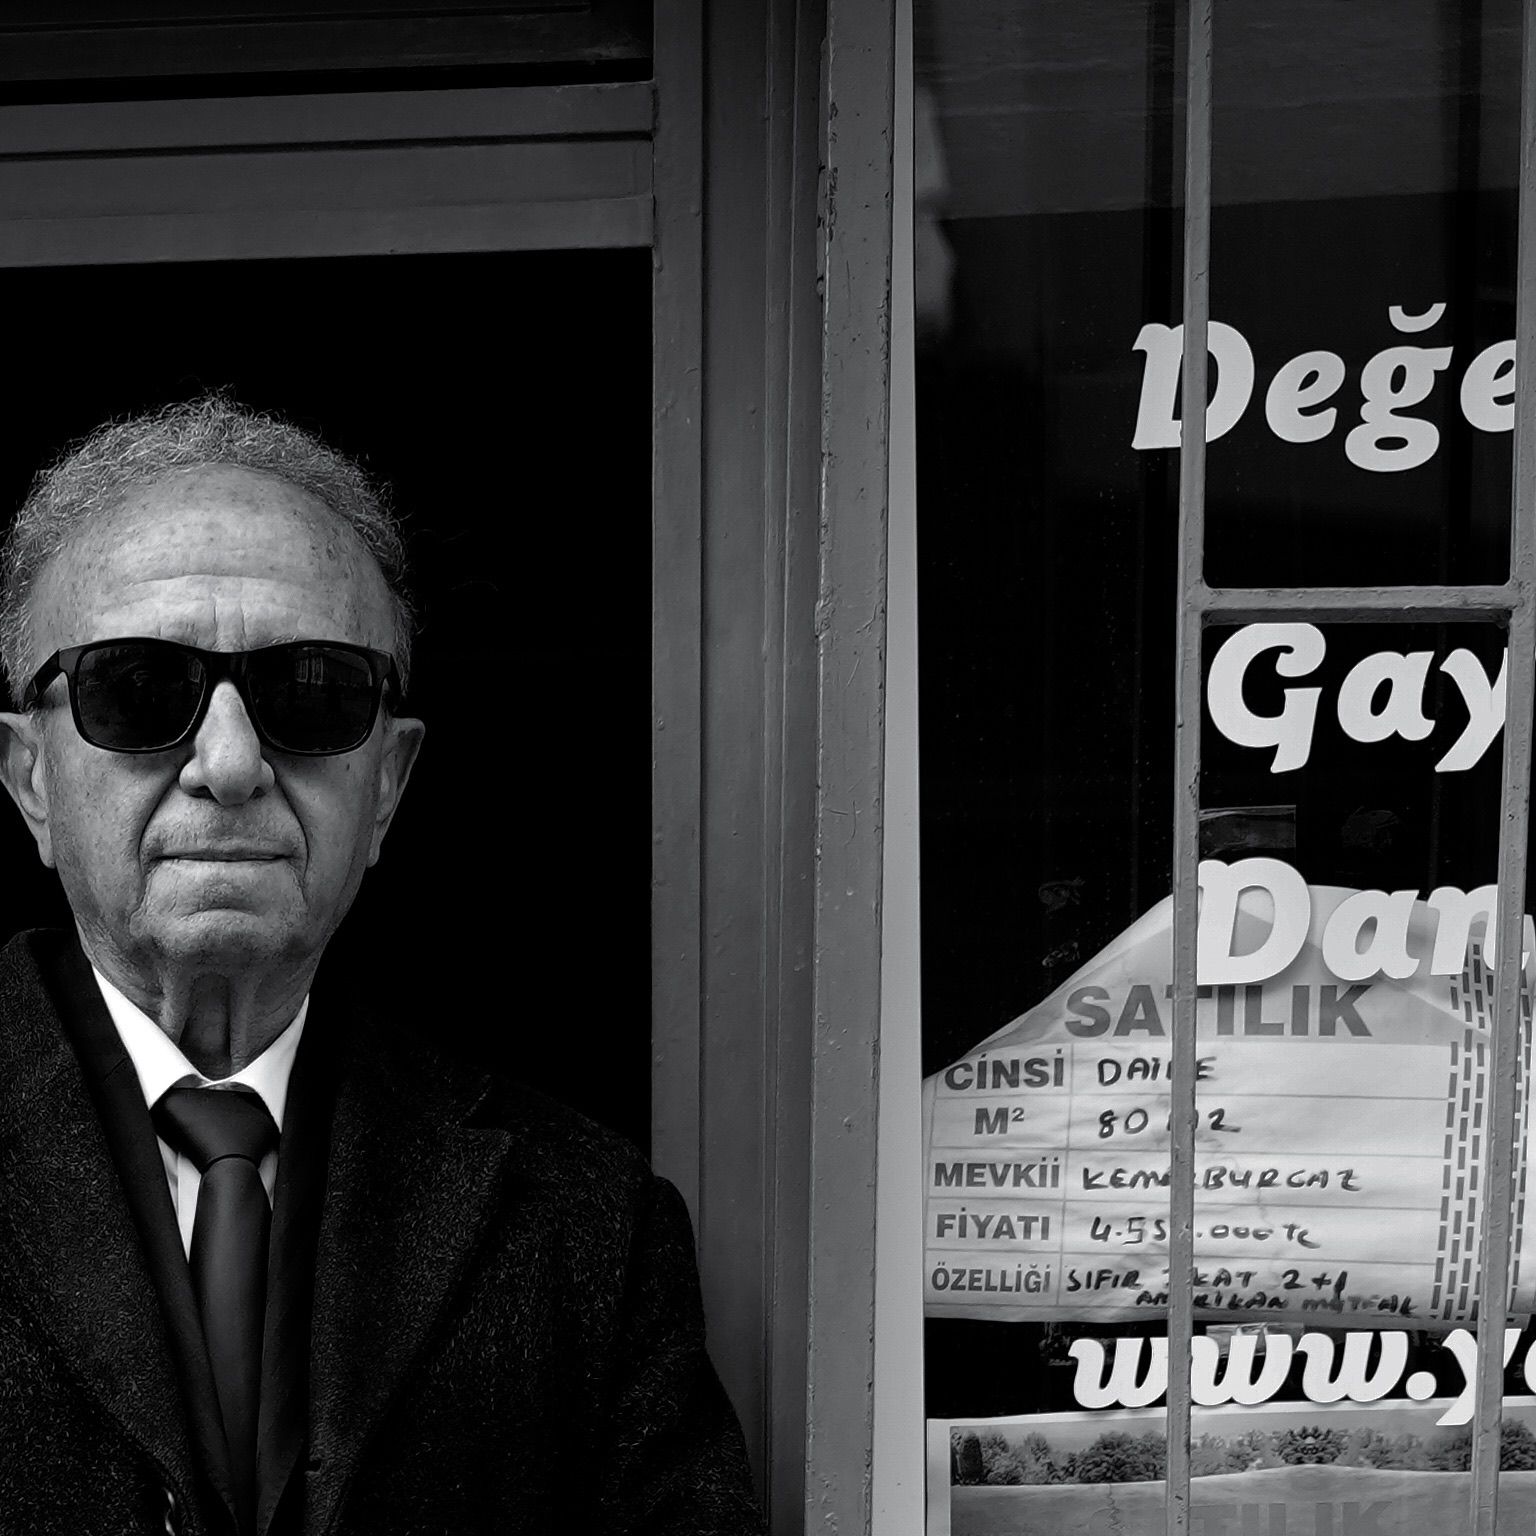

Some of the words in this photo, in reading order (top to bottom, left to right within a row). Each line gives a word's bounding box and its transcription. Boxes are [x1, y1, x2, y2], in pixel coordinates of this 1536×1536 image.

[1065, 984, 1372, 1037] SAILIK
[944, 1048, 1064, 1091] CİNSİ
[1098, 1108, 1149, 1138] 80
[934, 1157, 1060, 1188] MEVKİİ
[936, 1207, 1050, 1240] FİYATI
[931, 1262, 1051, 1292] ÖZELLİĞİ
[1068, 1328, 1536, 1427] www.y
